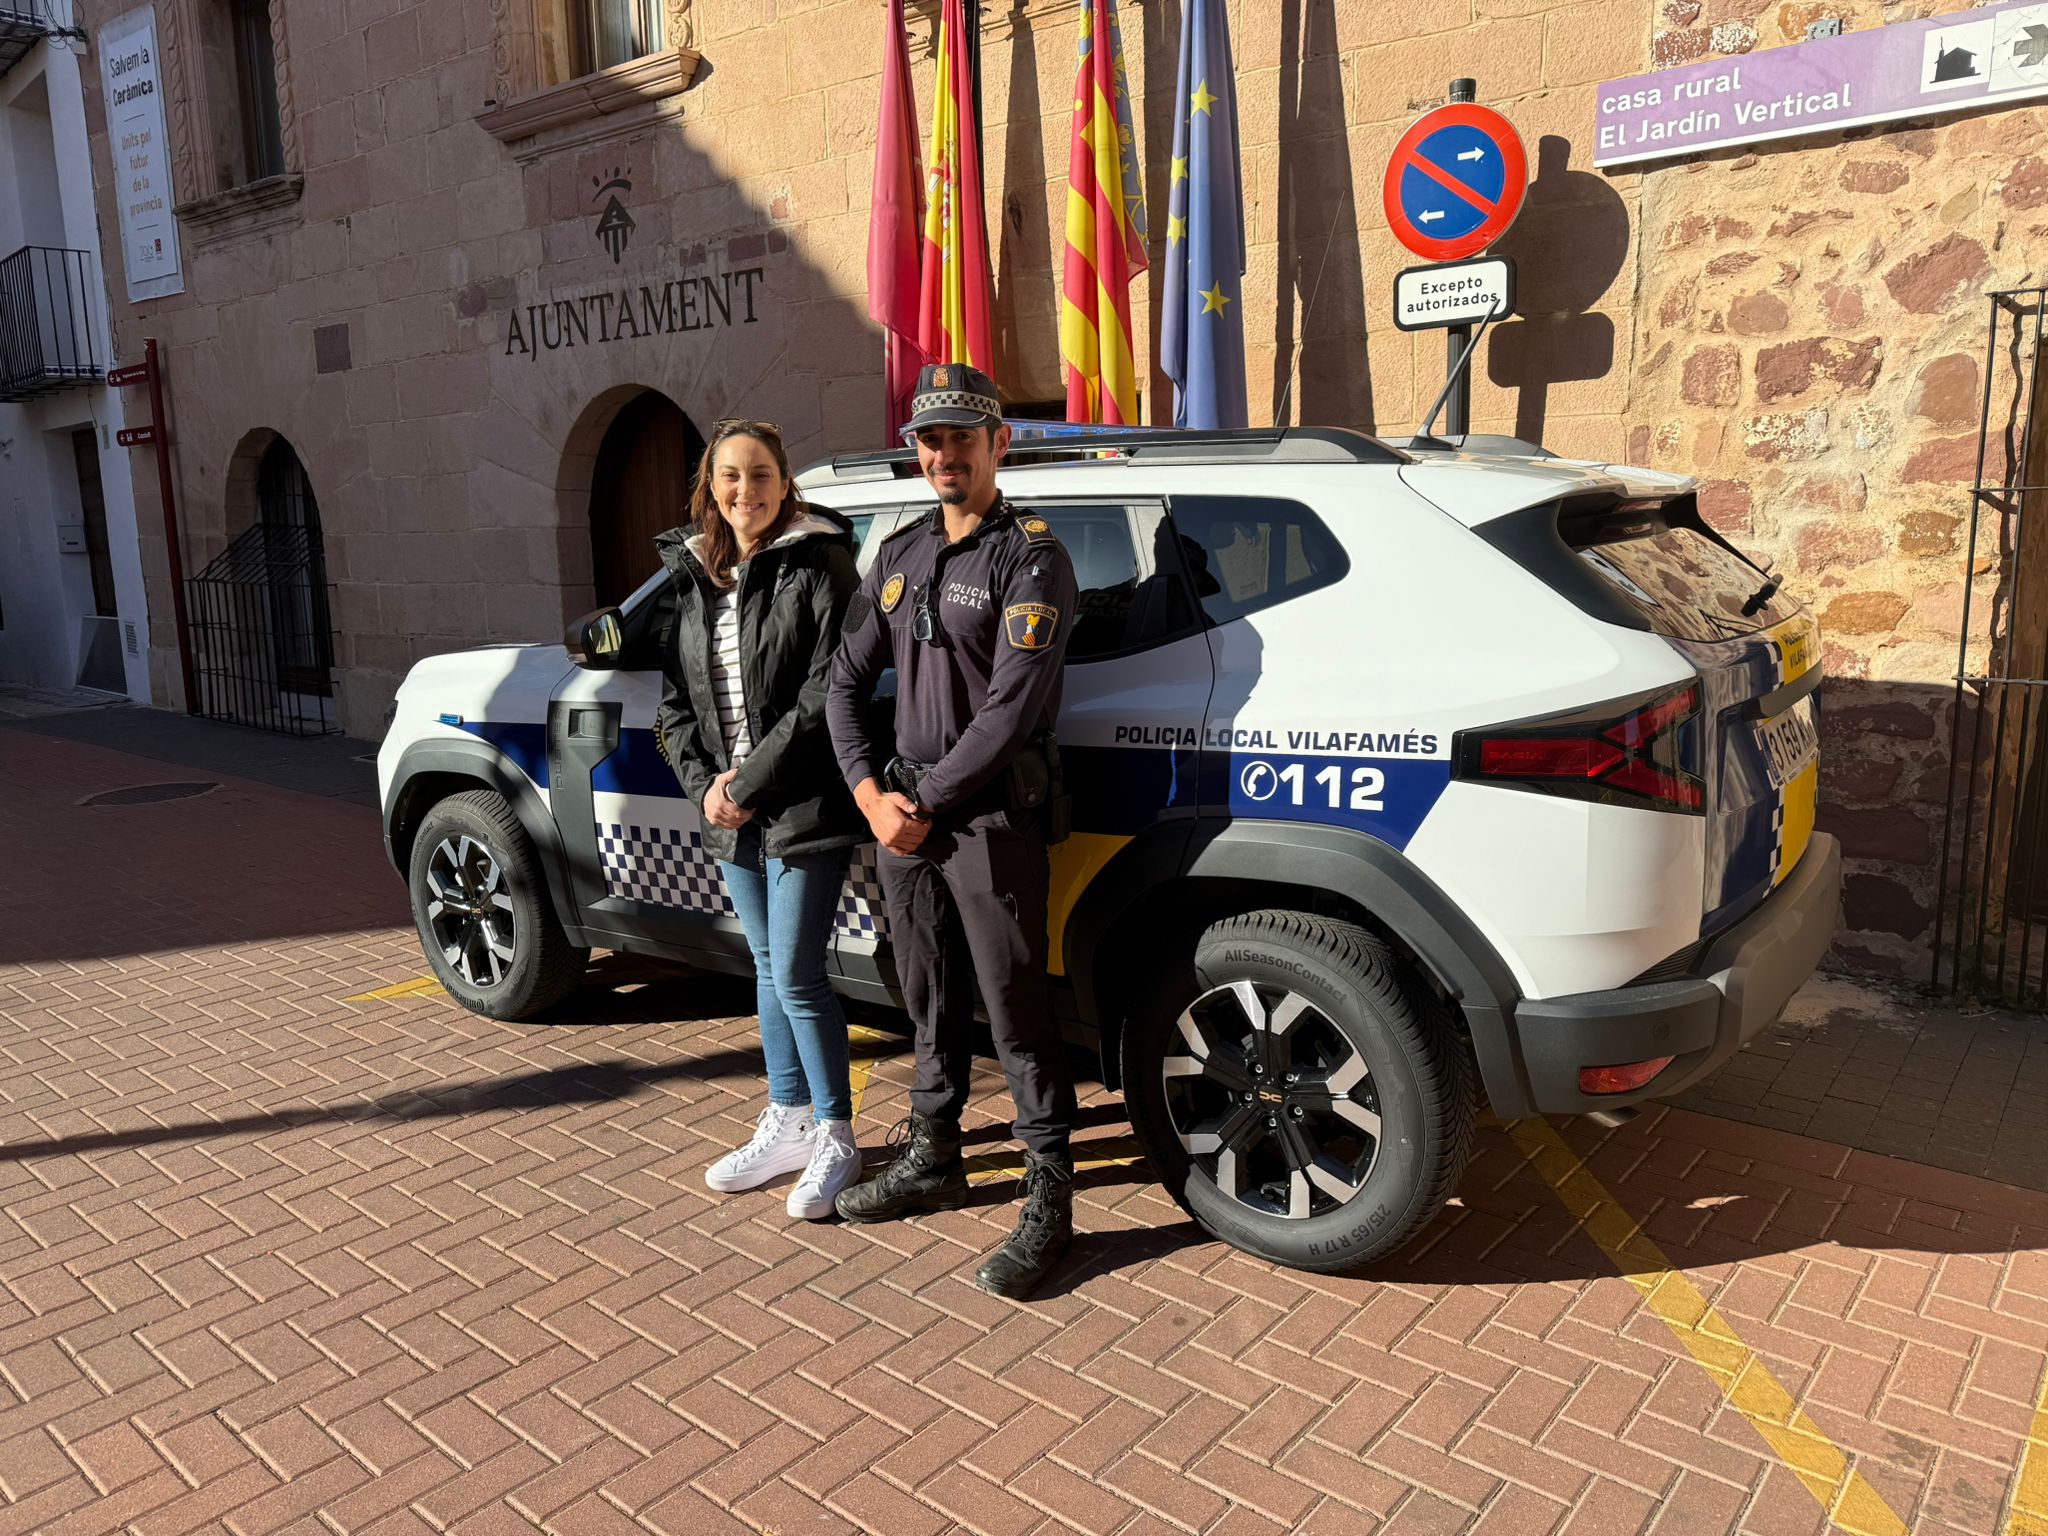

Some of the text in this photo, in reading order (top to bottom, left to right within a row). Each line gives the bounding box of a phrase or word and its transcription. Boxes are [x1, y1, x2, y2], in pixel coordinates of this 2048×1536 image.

[109, 44, 150, 78] Salvem la
[112, 77, 154, 106] Ceràmica
[1602, 66, 1741, 115] casa rural
[1600, 82, 1852, 149] El Jardín Vertical
[121, 127, 152, 151] Units pel
[129, 154, 149, 170] futur
[132, 174, 150, 192] de la
[1420, 277, 1483, 296] Excepto
[505, 267, 764, 362] AJUNTAMENT
[1406, 291, 1498, 313] autorizados
[947, 593, 984, 610] LOCAL
[948, 583, 991, 601] POLICIA
[1009, 606, 1053, 616] POLICIA LOCAL
[1114, 726, 1439, 755] POLICIA LOCAL VILAFAMÉS
[1278, 763, 1385, 812] 112
[1224, 948, 1348, 1005] AllSeasonContact
[1350, 1203, 1392, 1242] 215/65
